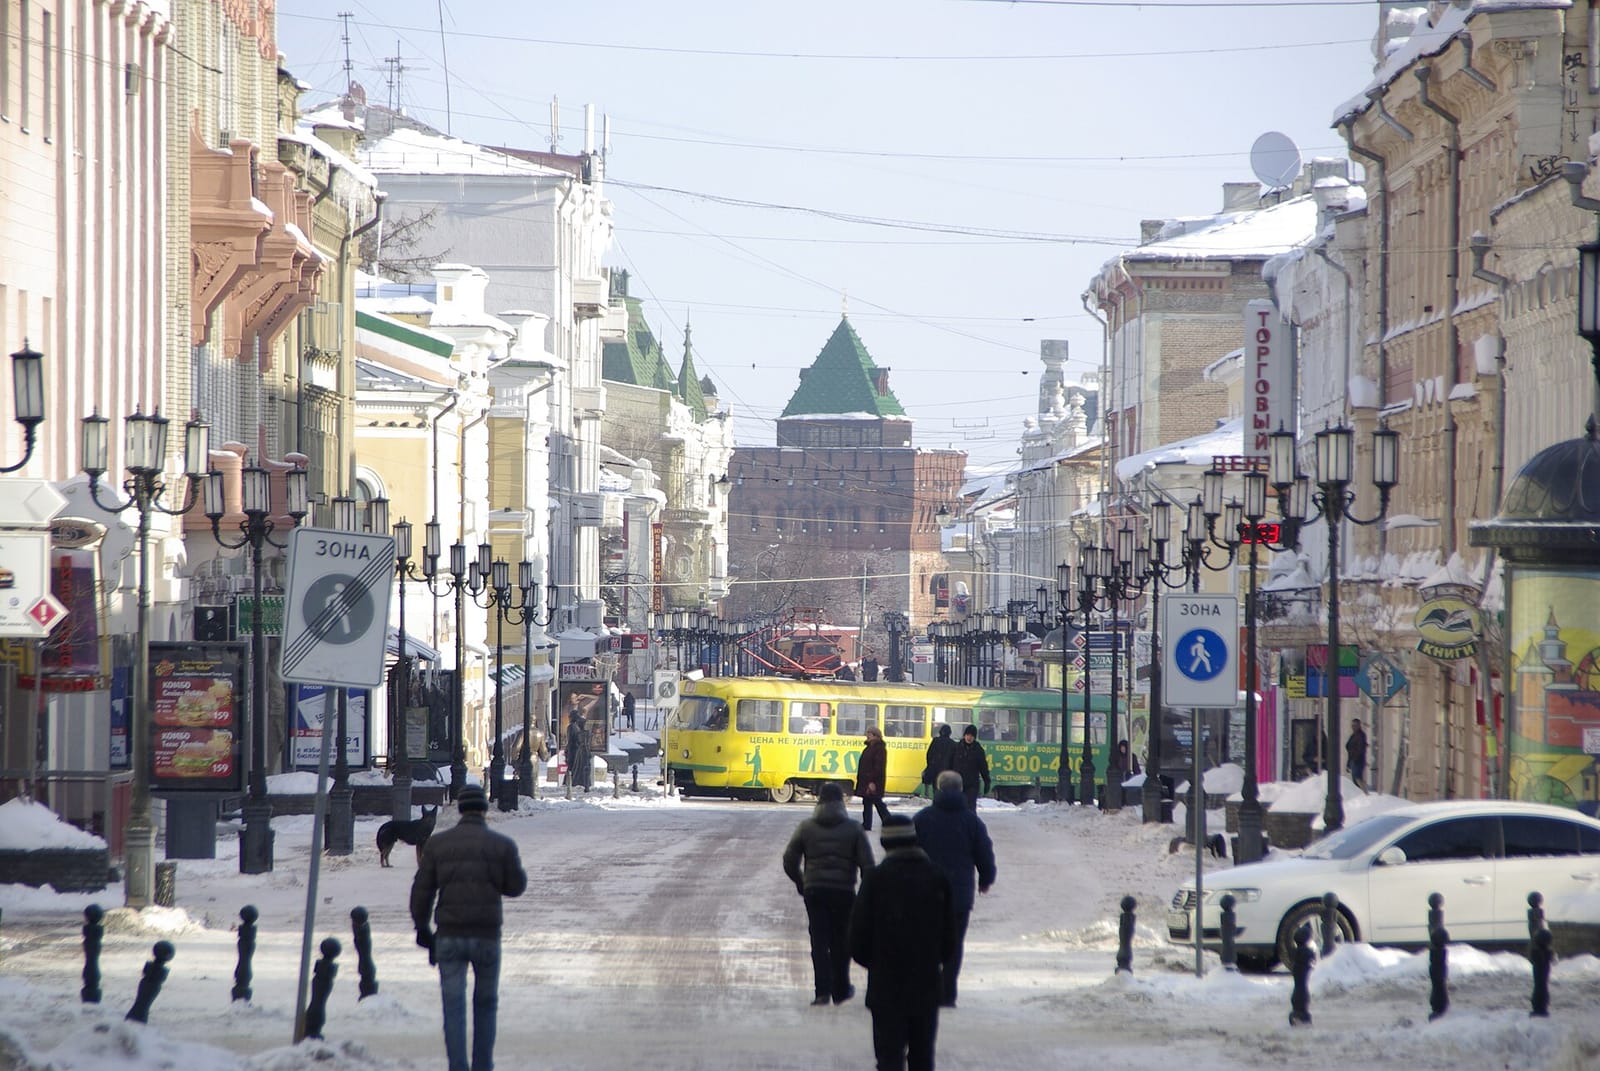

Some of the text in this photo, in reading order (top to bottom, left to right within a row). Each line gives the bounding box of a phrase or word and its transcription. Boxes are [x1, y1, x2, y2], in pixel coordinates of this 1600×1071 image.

[1253, 311, 1271, 450] ТОРГОВЫЙ
[315, 540, 370, 560] ЗОНА
[1180, 603, 1221, 616] ЗОНА
[1423, 643, 1474, 658] КНИГИ
[213, 711, 229, 720] 159
[212, 763, 229, 772] 159
